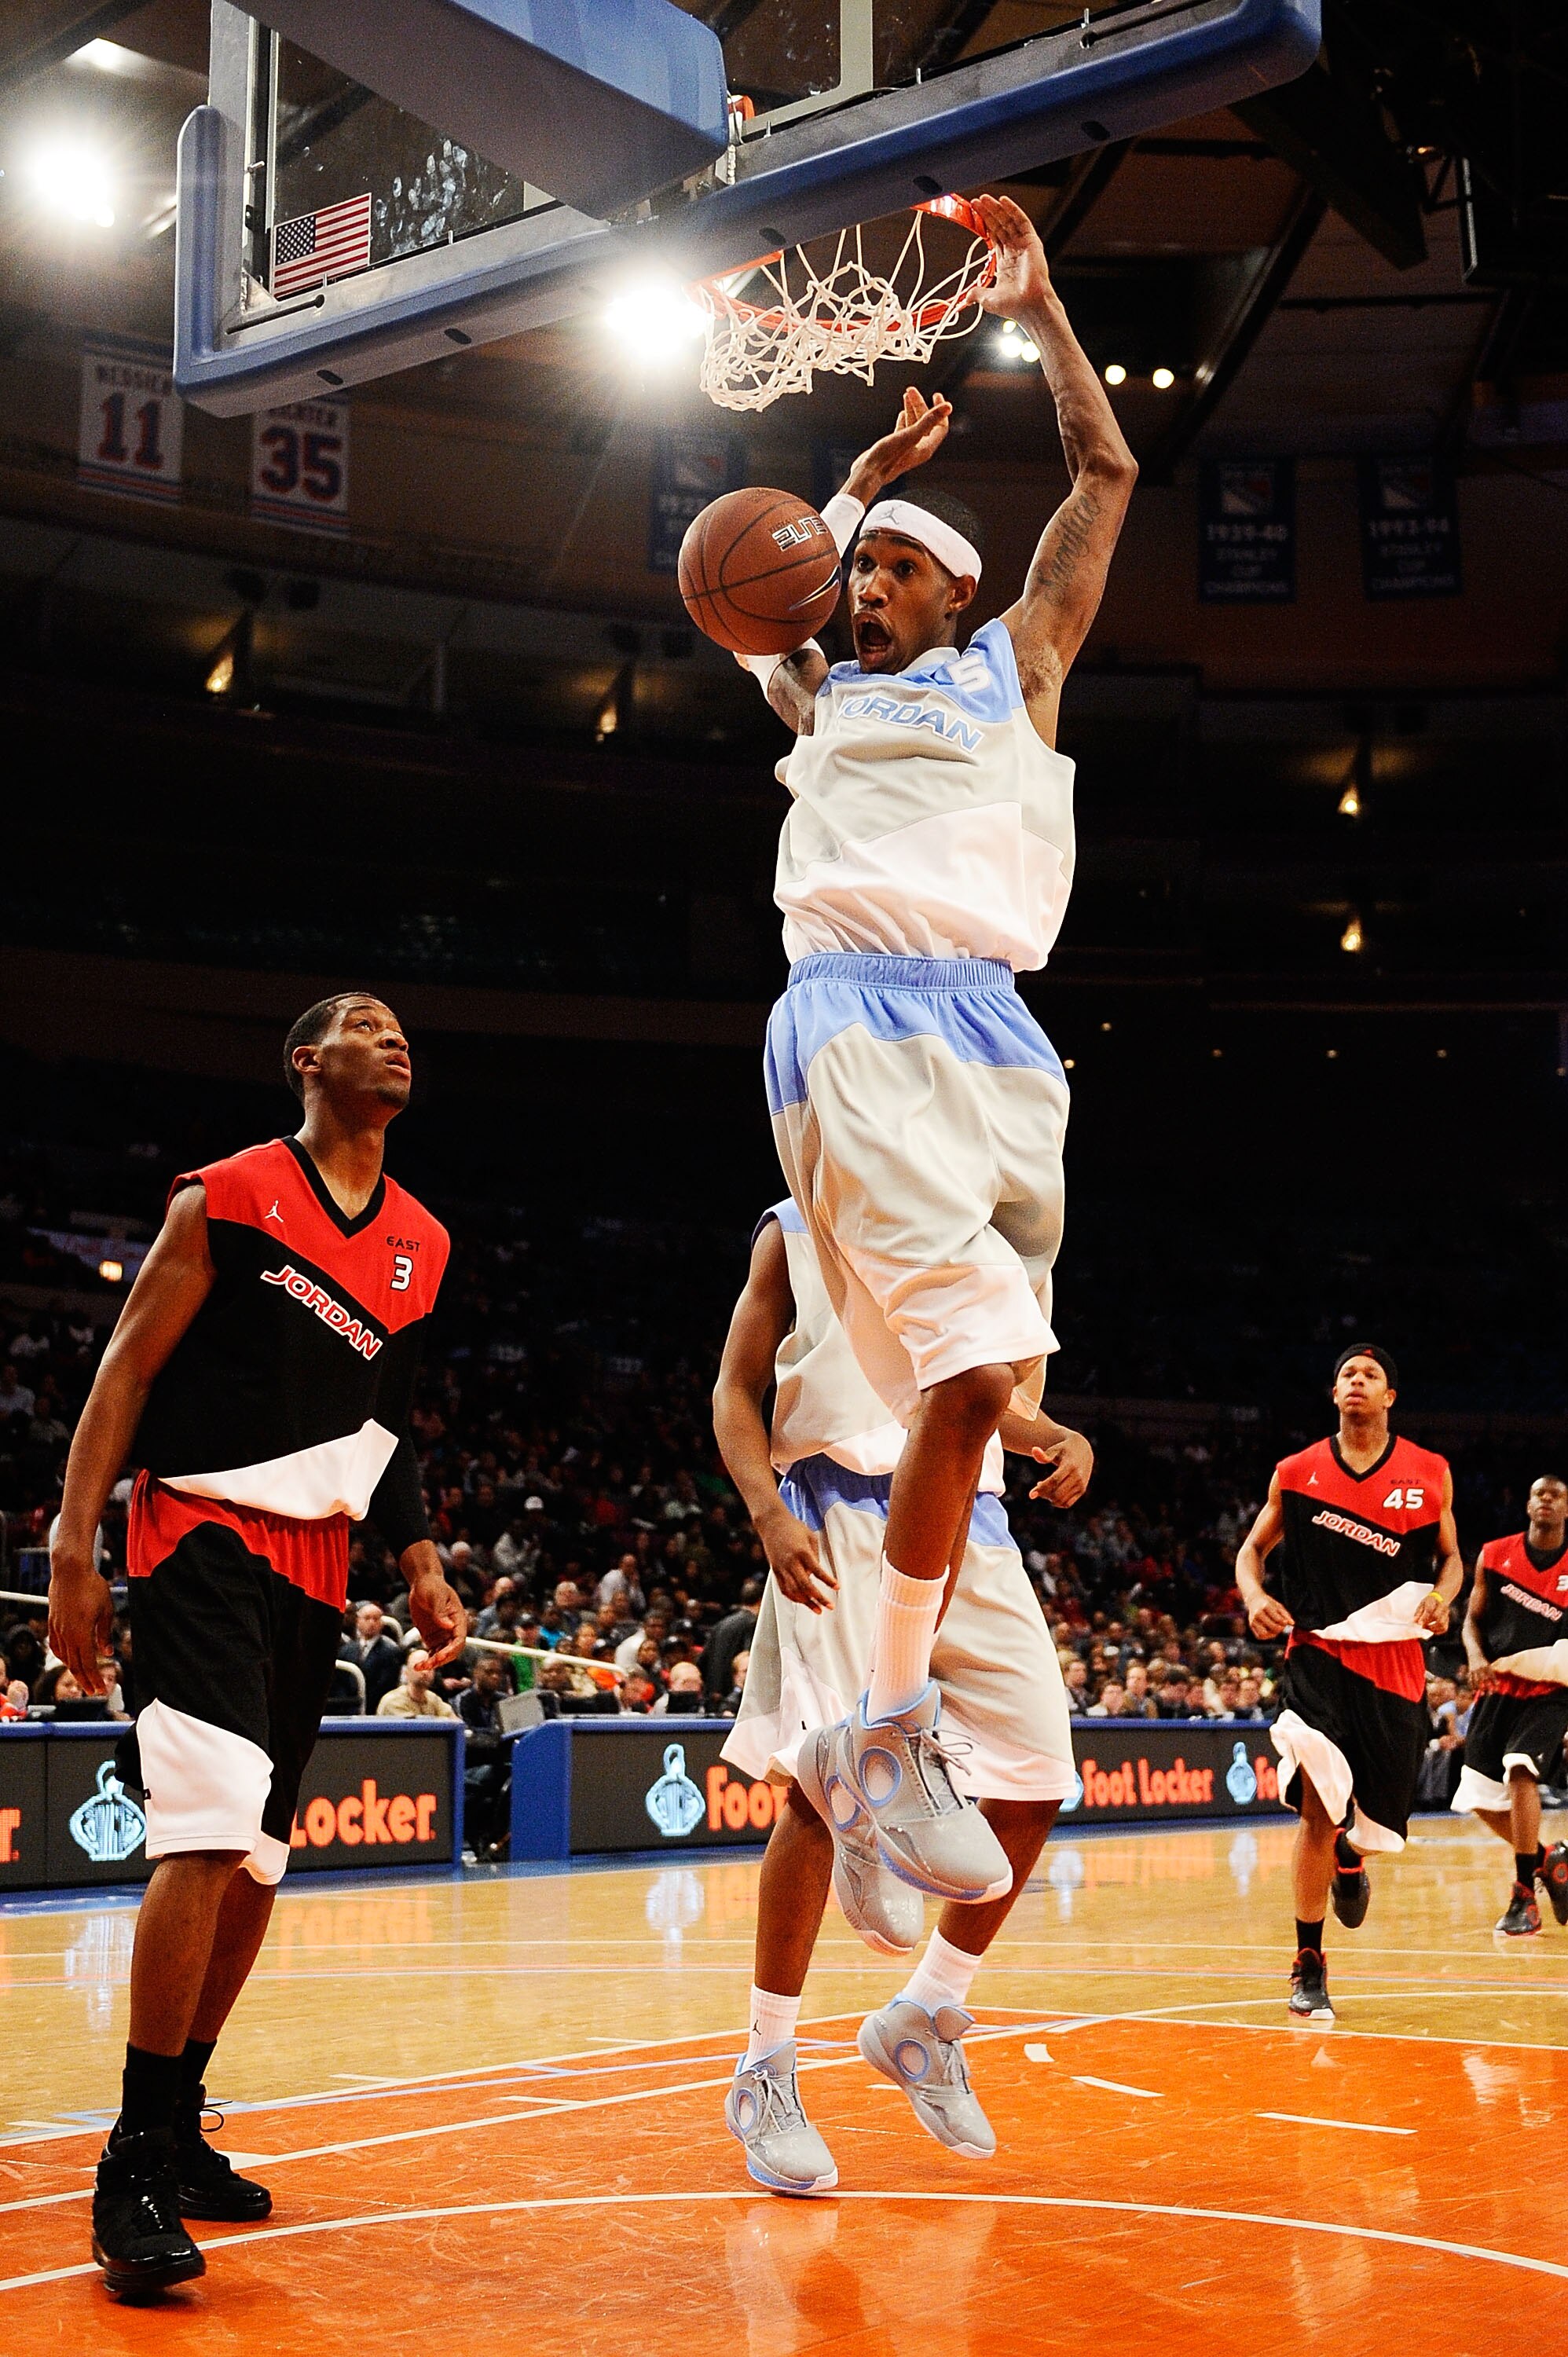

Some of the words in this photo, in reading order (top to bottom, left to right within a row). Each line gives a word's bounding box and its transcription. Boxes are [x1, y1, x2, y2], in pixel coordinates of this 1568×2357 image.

[97, 390, 164, 470] 11
[260, 424, 343, 503] 35
[947, 654, 991, 694] 5
[839, 695, 985, 753] ORDAN
[387, 1236, 420, 1252] EAST
[390, 1253, 413, 1292] 3
[260, 1264, 383, 1361] JORDAN
[1383, 1488, 1424, 1509] 45
[1312, 1510, 1401, 1557] JORDAN
[1500, 1583, 1563, 1622] JORDAN
[1082, 1758, 1137, 1808] Foot
[1138, 1756, 1214, 1805] Locker
